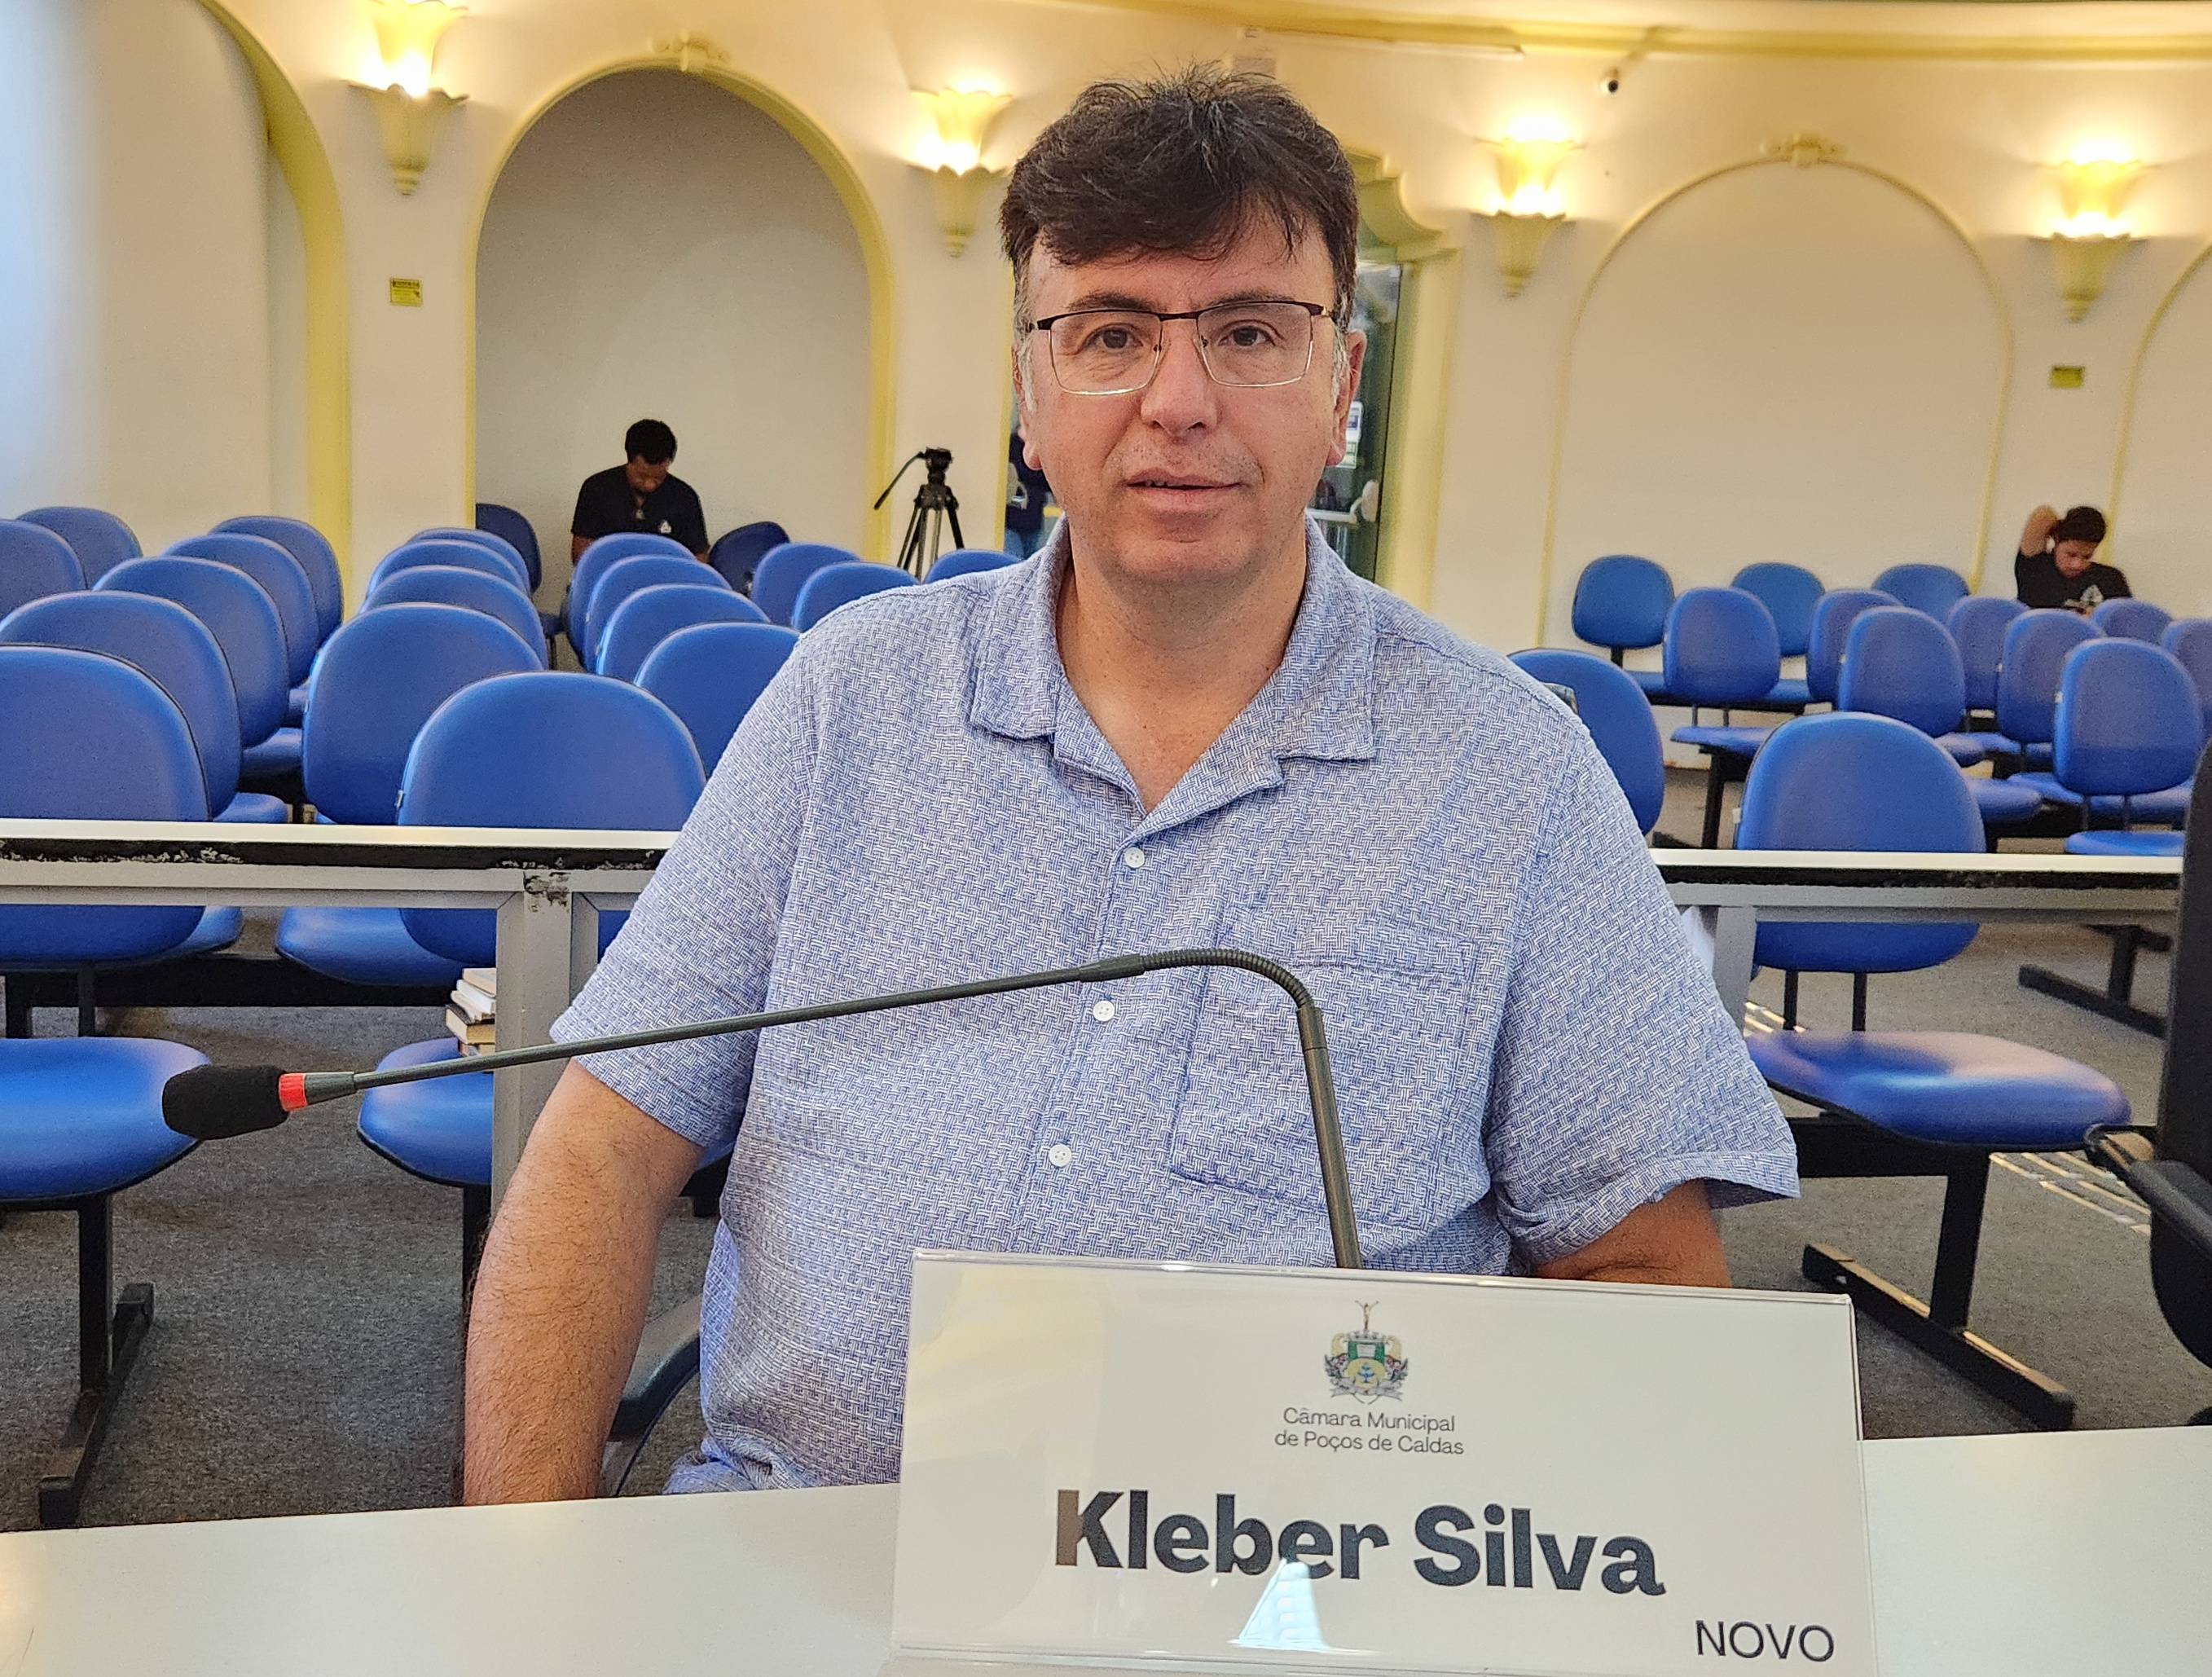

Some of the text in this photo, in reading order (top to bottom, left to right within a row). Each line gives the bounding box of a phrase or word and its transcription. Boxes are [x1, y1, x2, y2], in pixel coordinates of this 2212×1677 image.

[1283, 1406, 1456, 1435] Câmara Municipal
[1274, 1430, 1465, 1455] de Poços de Caldas
[1055, 1489, 1667, 1596] Kleber Silva
[1695, 1620, 1835, 1662] NOVO
